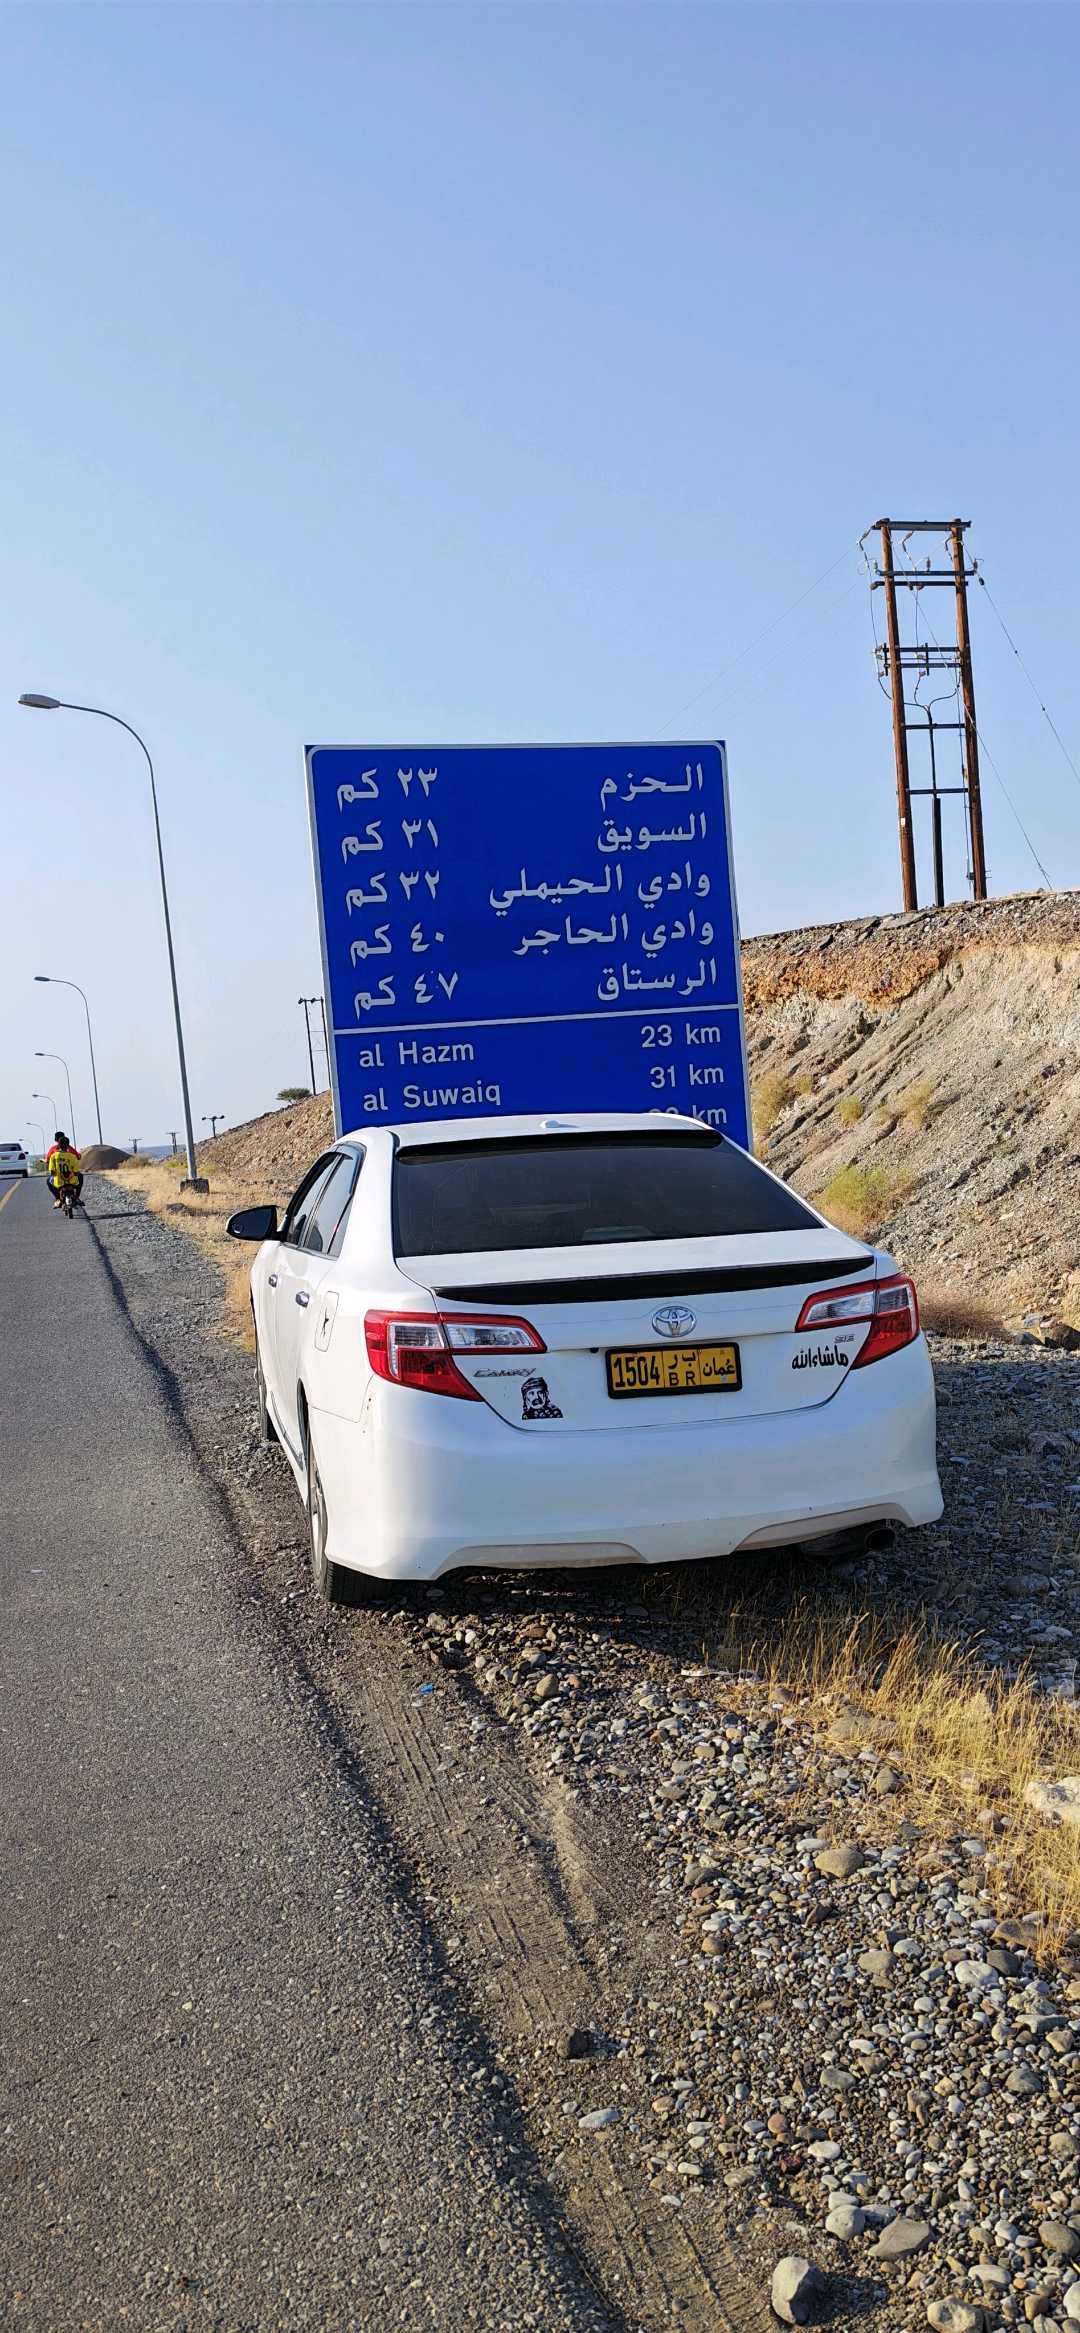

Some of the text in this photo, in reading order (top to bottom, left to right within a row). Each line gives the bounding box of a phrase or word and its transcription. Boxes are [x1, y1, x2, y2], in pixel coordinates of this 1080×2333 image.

[336, 767, 438, 810] ٢٣ كم
[601, 763, 704, 810] الحزم
[341, 819, 439, 864] ٣١ كم
[597, 811, 707, 853] السويق
[345, 871, 440, 915] ٣٢ كم
[489, 861, 711, 918] وادي الحيملي
[350, 922, 445, 967] ٤٠ كم
[512, 910, 715, 959] وادي الحاجر
[354, 971, 459, 1019] ٤٧ كم
[597, 958, 717, 1000] الرستاق
[359, 1041, 475, 1068] al Hazm
[641, 1023, 721, 1048] 23 km
[363, 1080, 501, 1112] al Suwaiq
[650, 1063, 724, 1089] 31 km
[692, 1104, 727, 1125] km
[613, 1355, 660, 1387] 1504
